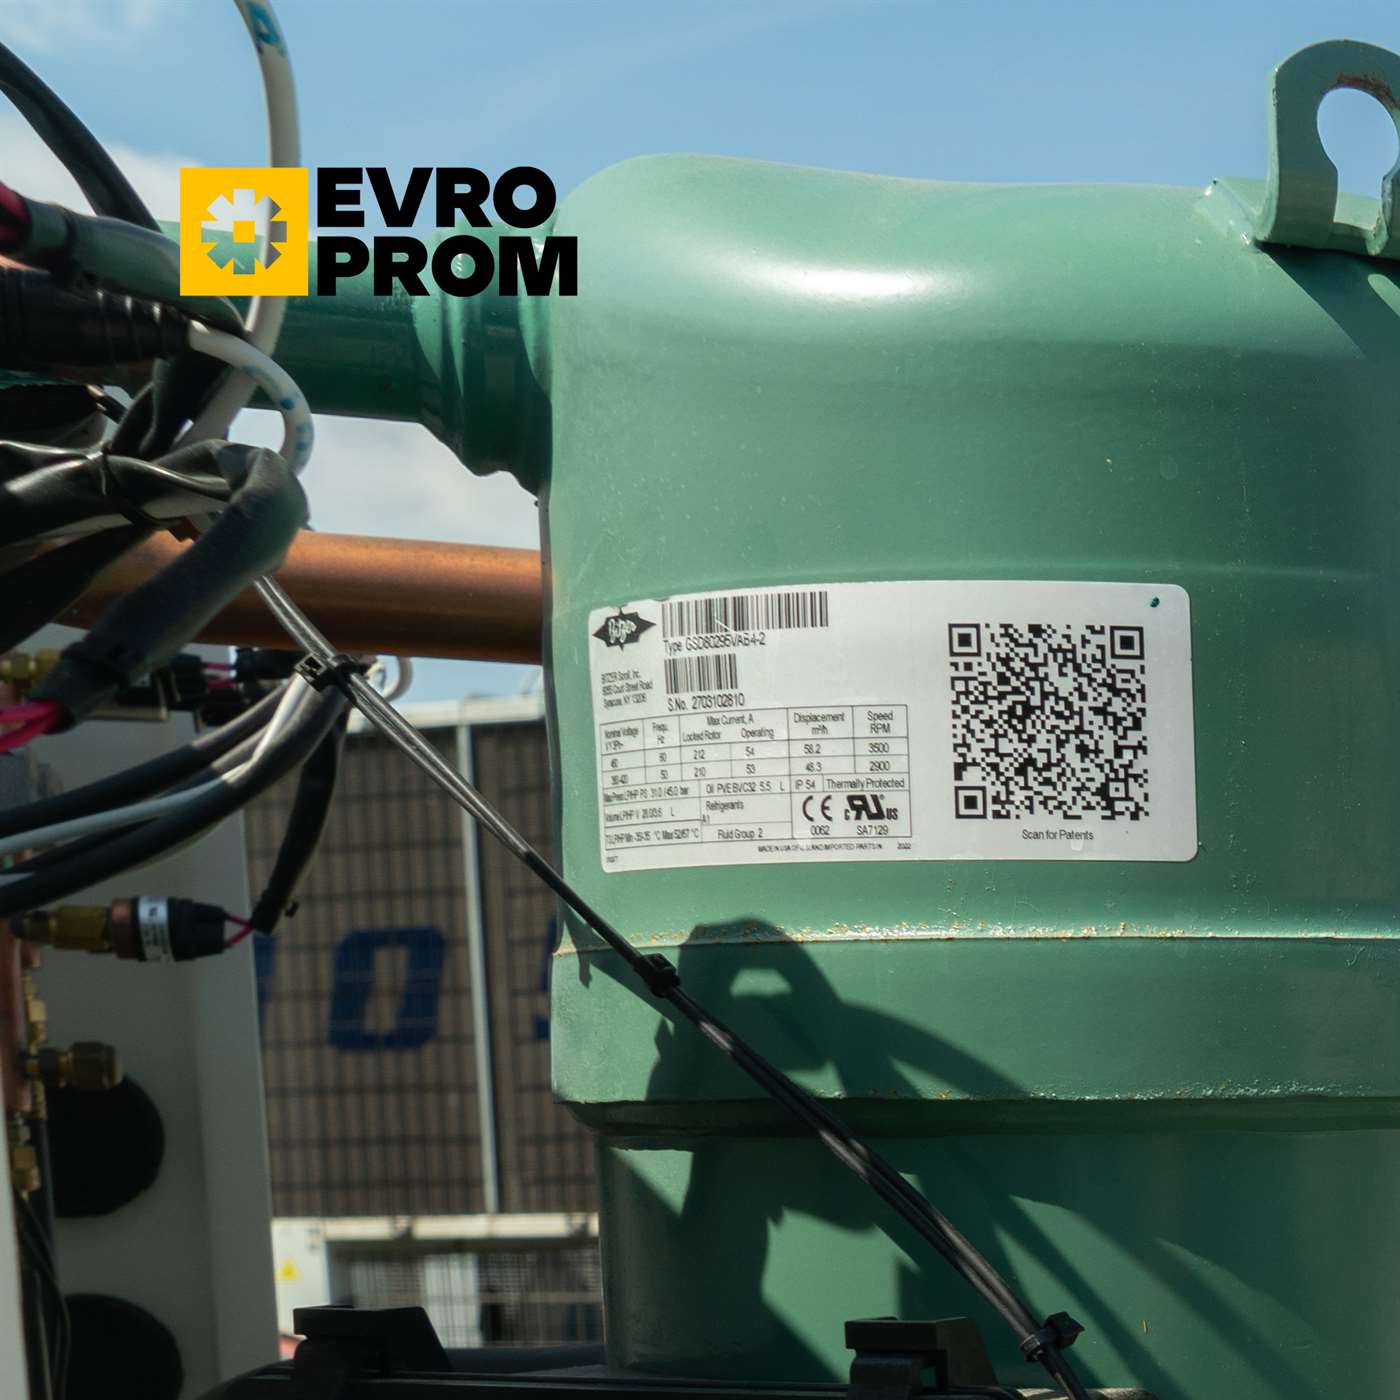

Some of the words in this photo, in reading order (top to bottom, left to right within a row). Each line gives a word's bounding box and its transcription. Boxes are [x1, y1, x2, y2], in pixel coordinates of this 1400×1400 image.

[664, 640, 682, 655] Type
[668, 699, 687, 712] S.No.
[692, 693, 745, 709] 2703102810
[748, 714, 754, 722] A
[794, 712, 844, 723] Displacement
[868, 710, 893, 721] Speed
[741, 727, 774, 739] Operating
[871, 723, 891, 734] RPM
[746, 746, 754, 756] 54
[804, 744, 821, 754] 58.2
[868, 742, 889, 753] 3500
[694, 750, 705, 760] 212
[746, 764, 756, 774] 53
[869, 761, 890, 771] 2900
[694, 767, 706, 777] 210
[706, 784, 714, 792] Oil
[717, 783, 732, 792] PVE
[760, 781, 772, 791] 5.5
[795, 780, 804, 790] IP
[805, 779, 816, 789] 54
[828, 780, 864, 791] Thermally
[866, 778, 904, 789] Protected
[706, 800, 744, 812] Refrigerants
[803, 795, 832, 822] CE
[735, 830, 755, 840] Group
[758, 828, 763, 838] 2
[811, 825, 830, 836] 0062
[857, 825, 888, 836] SA7129
[1022, 829, 1044, 840] Scan
[1046, 830, 1057, 839] for
[1059, 829, 1094, 840] Patents
